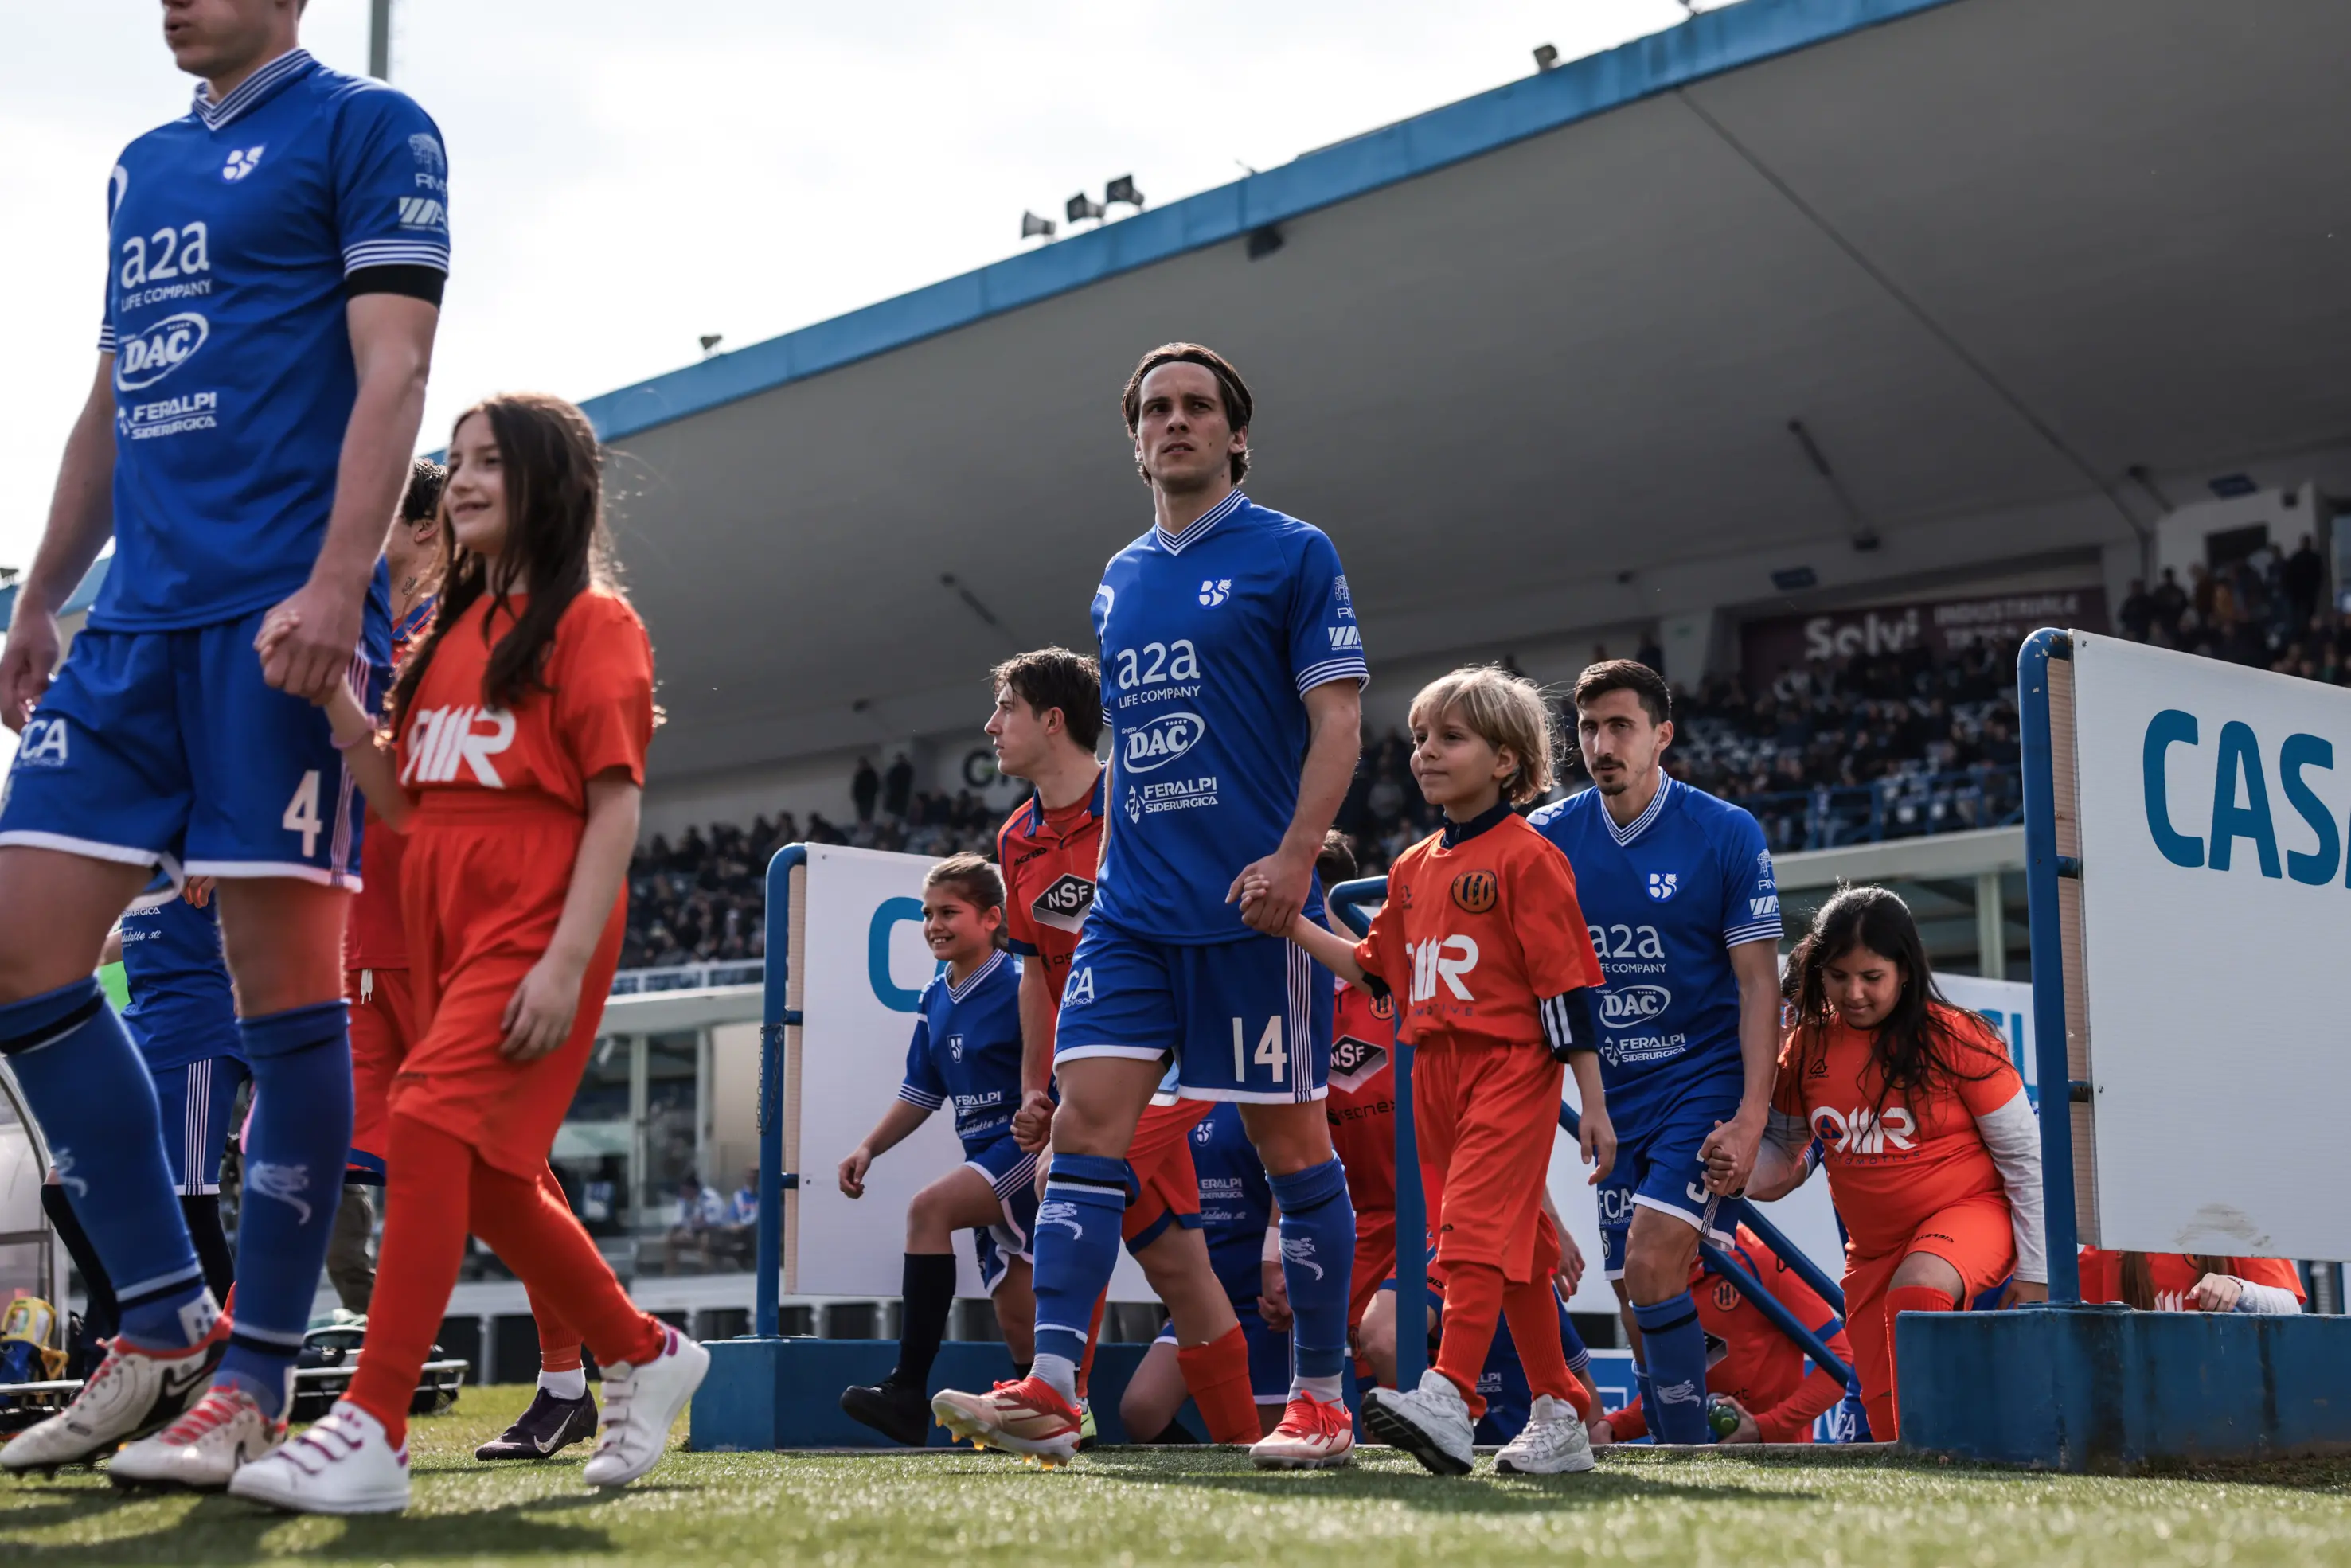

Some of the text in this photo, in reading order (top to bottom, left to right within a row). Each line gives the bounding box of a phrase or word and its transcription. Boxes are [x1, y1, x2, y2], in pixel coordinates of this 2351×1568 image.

[121, 220, 210, 289] a2a
[121, 279, 212, 312] LIFE COMPANY
[122, 329, 191, 374] DAC
[133, 391, 217, 422] FERALPI
[131, 415, 217, 440] SIDERURGICA
[1117, 639, 1200, 690] a2a
[1119, 685, 1201, 709] LIFE COMPANY
[1121, 726, 1137, 735] Gruppo
[1129, 724, 1189, 759] DAC
[1143, 776, 1217, 799] FERALPI
[2143, 709, 2351, 889] CAS
[282, 769, 323, 858] 4
[1145, 795, 1218, 813] SIDERURGICA
[1047, 883, 1088, 909] NSF
[1587, 924, 1665, 958] a2a
[1600, 963, 1666, 973] FE COMPANY
[1603, 994, 1659, 1016] DAC
[1232, 1015, 1287, 1082] 14
[1619, 1033, 1685, 1051] FERALPI
[1330, 1043, 1365, 1067] NSF
[1621, 1047, 1686, 1063] SIDERURGICA
[1831, 1151, 1921, 1165] TOMOTIVE
[1201, 1178, 1242, 1189] ERALPI
